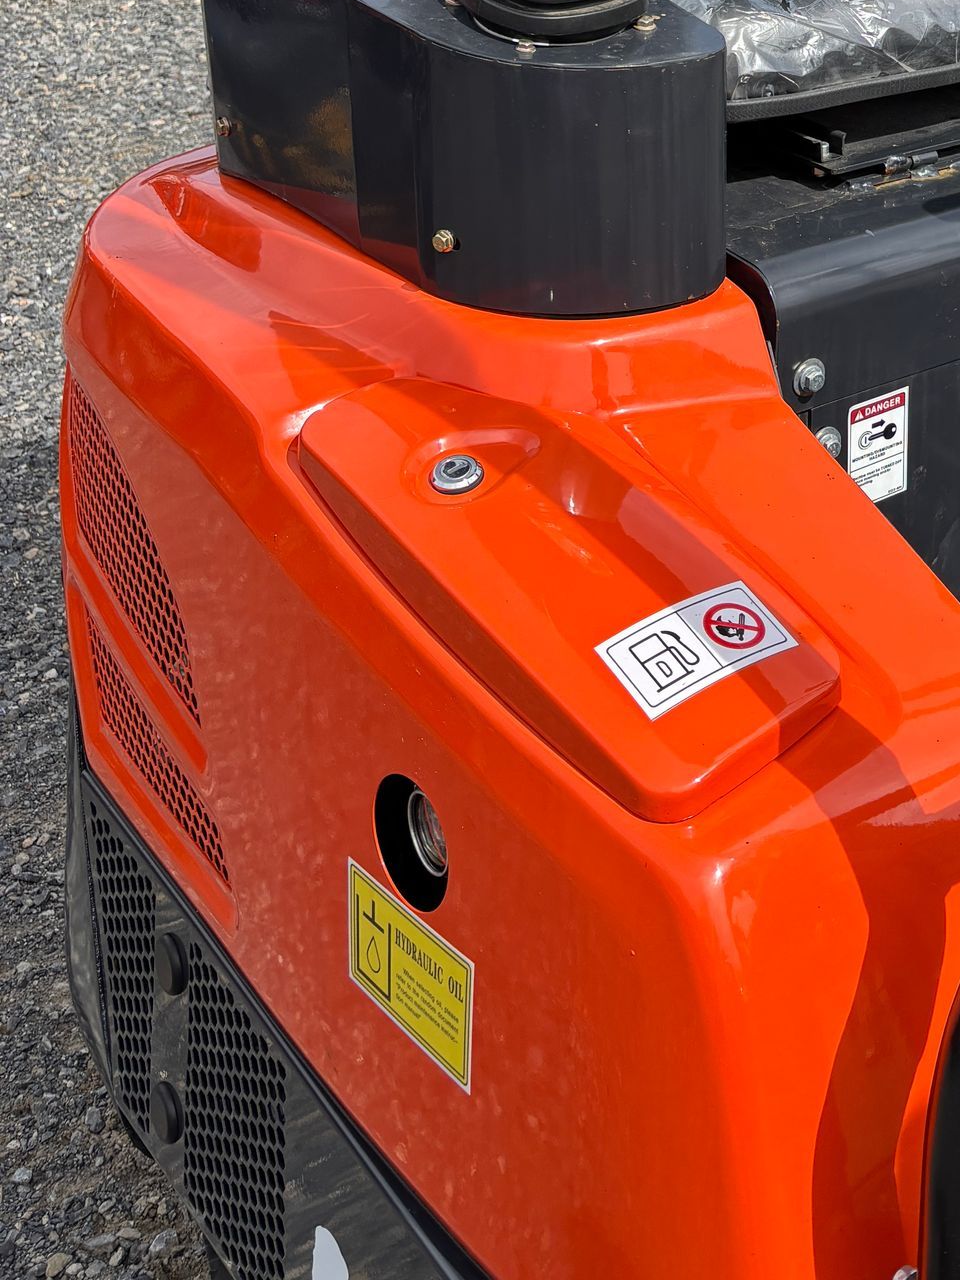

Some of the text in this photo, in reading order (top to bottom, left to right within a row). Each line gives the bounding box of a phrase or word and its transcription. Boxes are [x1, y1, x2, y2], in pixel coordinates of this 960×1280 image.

[865, 396, 901, 416] DANGER
[395, 927, 464, 1003] HYDRAULIC OIL
